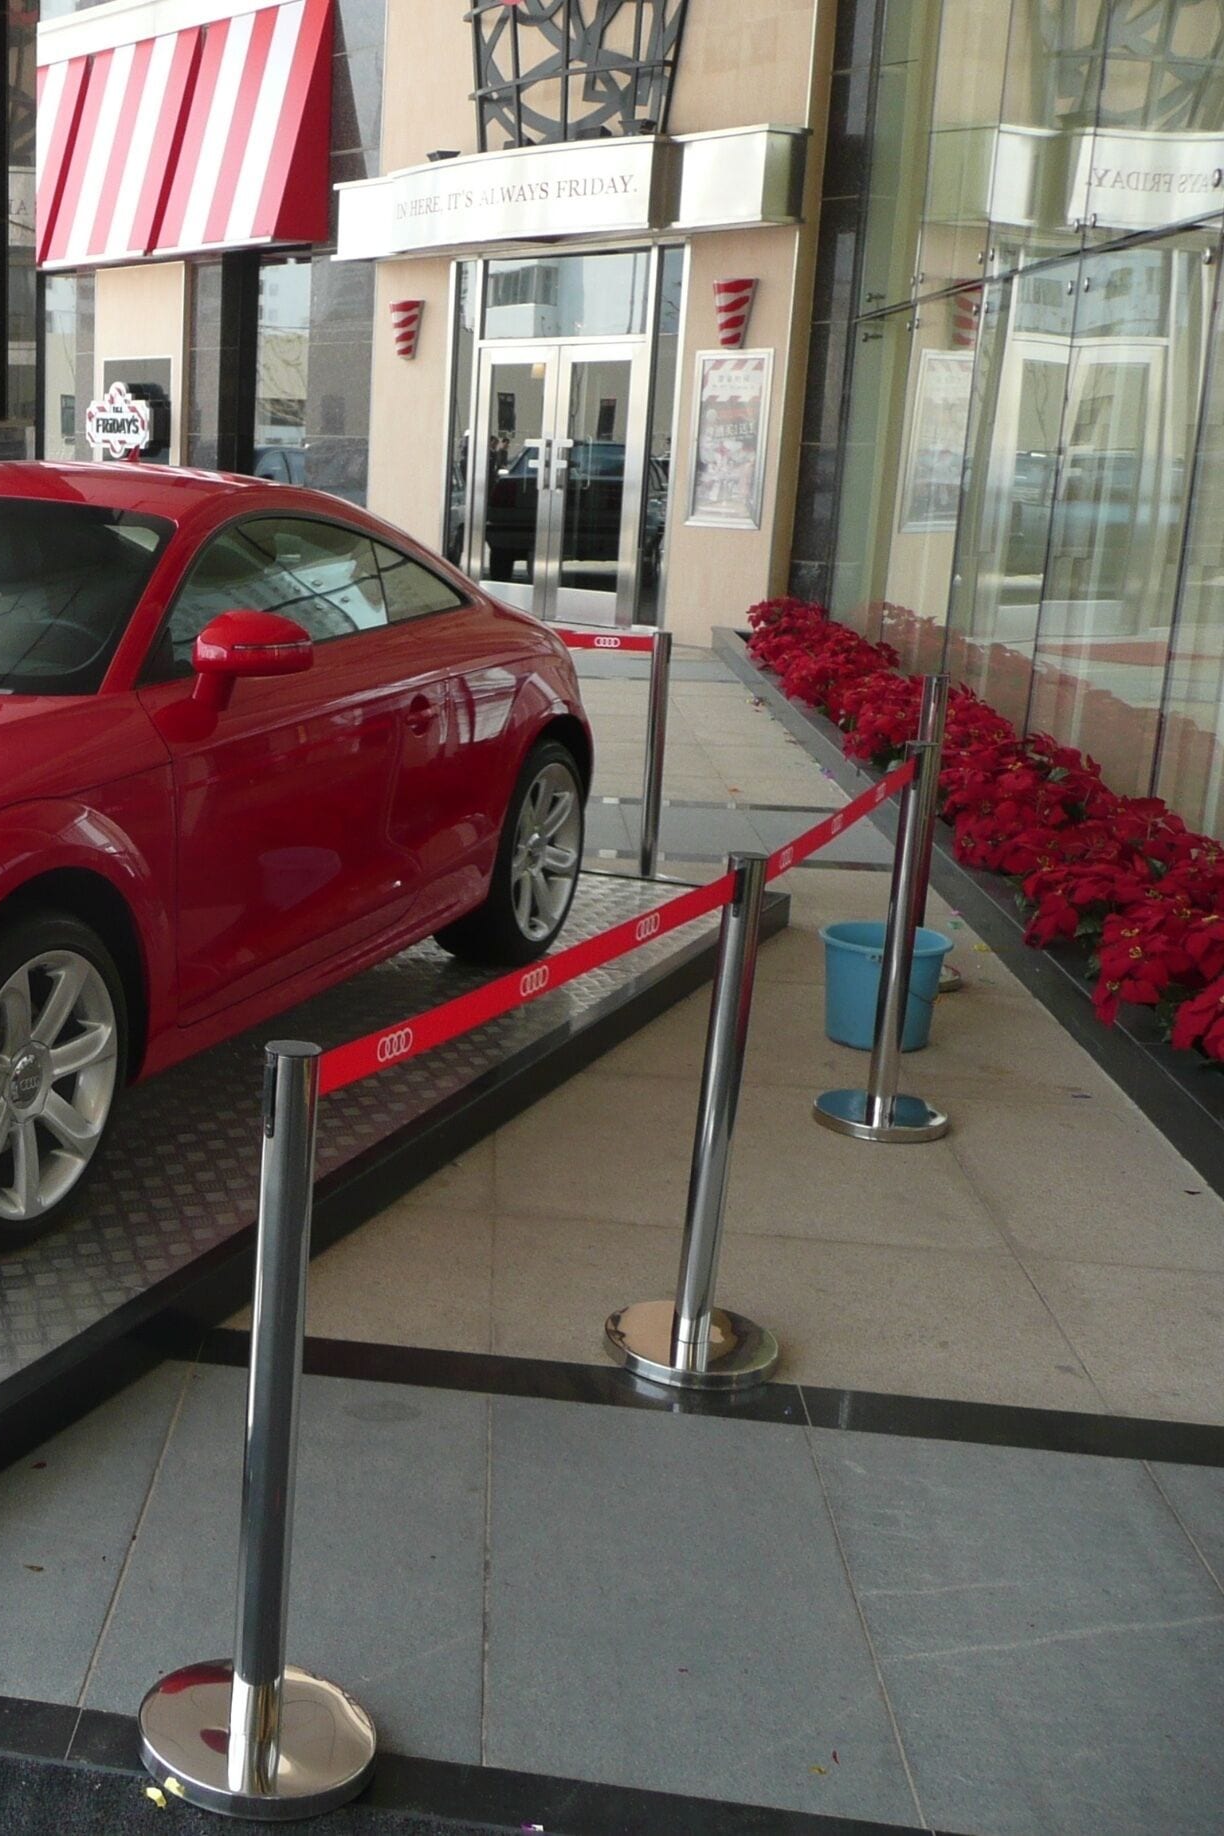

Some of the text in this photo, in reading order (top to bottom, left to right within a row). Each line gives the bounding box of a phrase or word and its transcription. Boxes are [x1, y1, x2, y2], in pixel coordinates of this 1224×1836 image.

[396, 174, 638, 220] IN HERE, IT'S ALWAYS FRIDAY.
